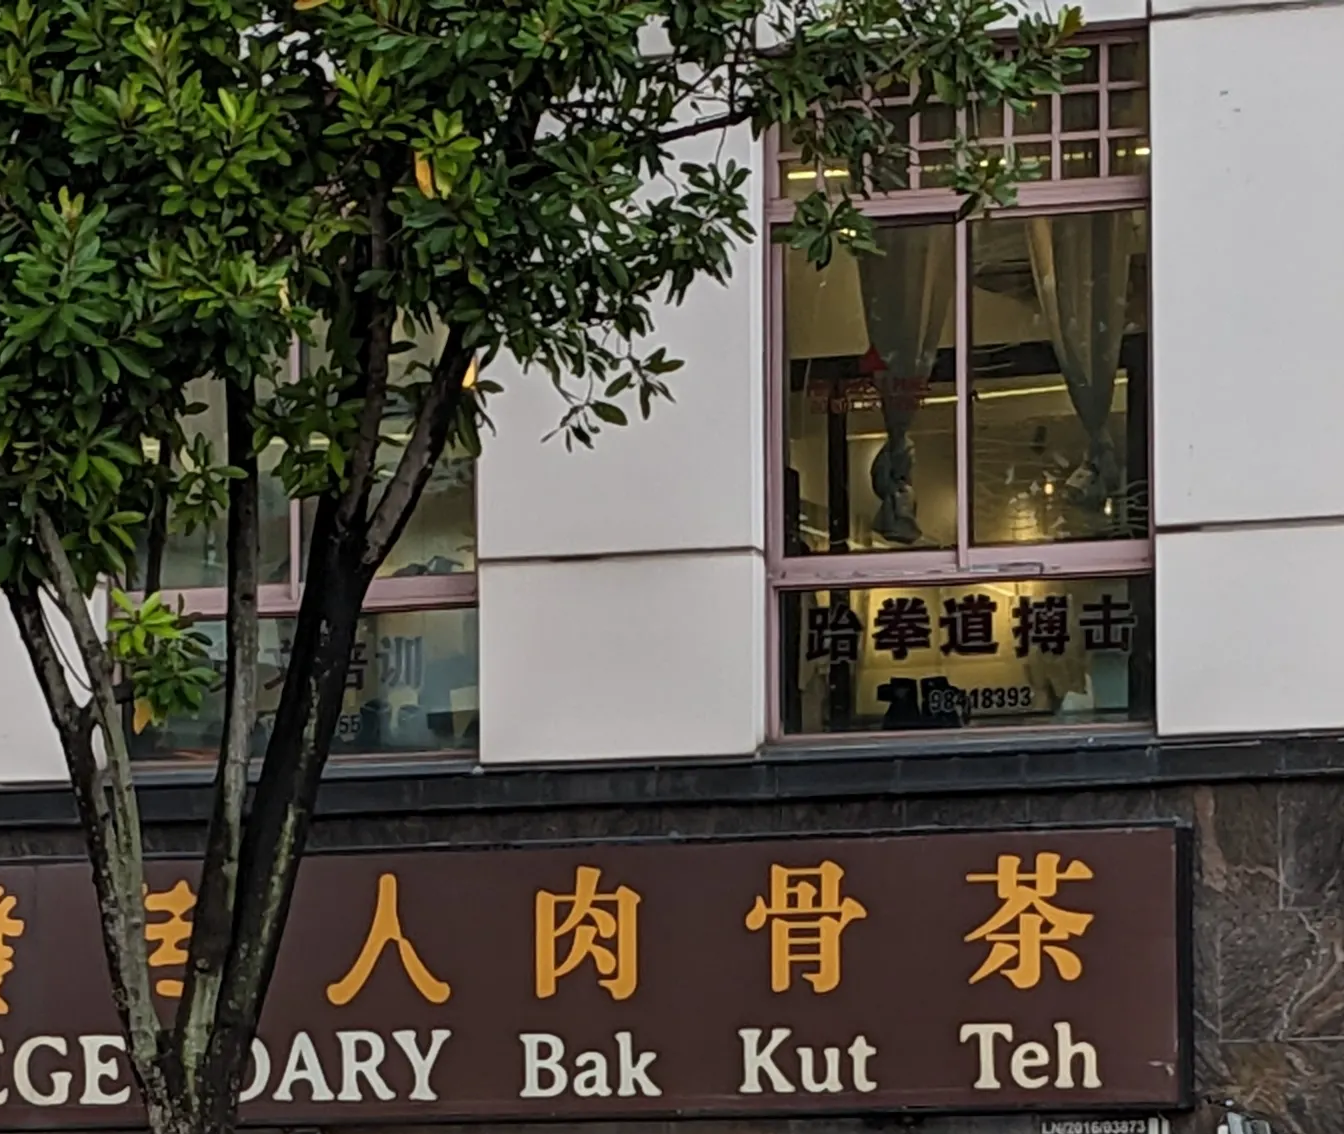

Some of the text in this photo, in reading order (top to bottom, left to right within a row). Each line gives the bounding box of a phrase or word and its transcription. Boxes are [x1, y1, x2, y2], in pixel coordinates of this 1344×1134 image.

[520, 1030, 662, 1099] Bak
[738, 1026, 879, 1095] Kut
[959, 1022, 1103, 1091] Teh
